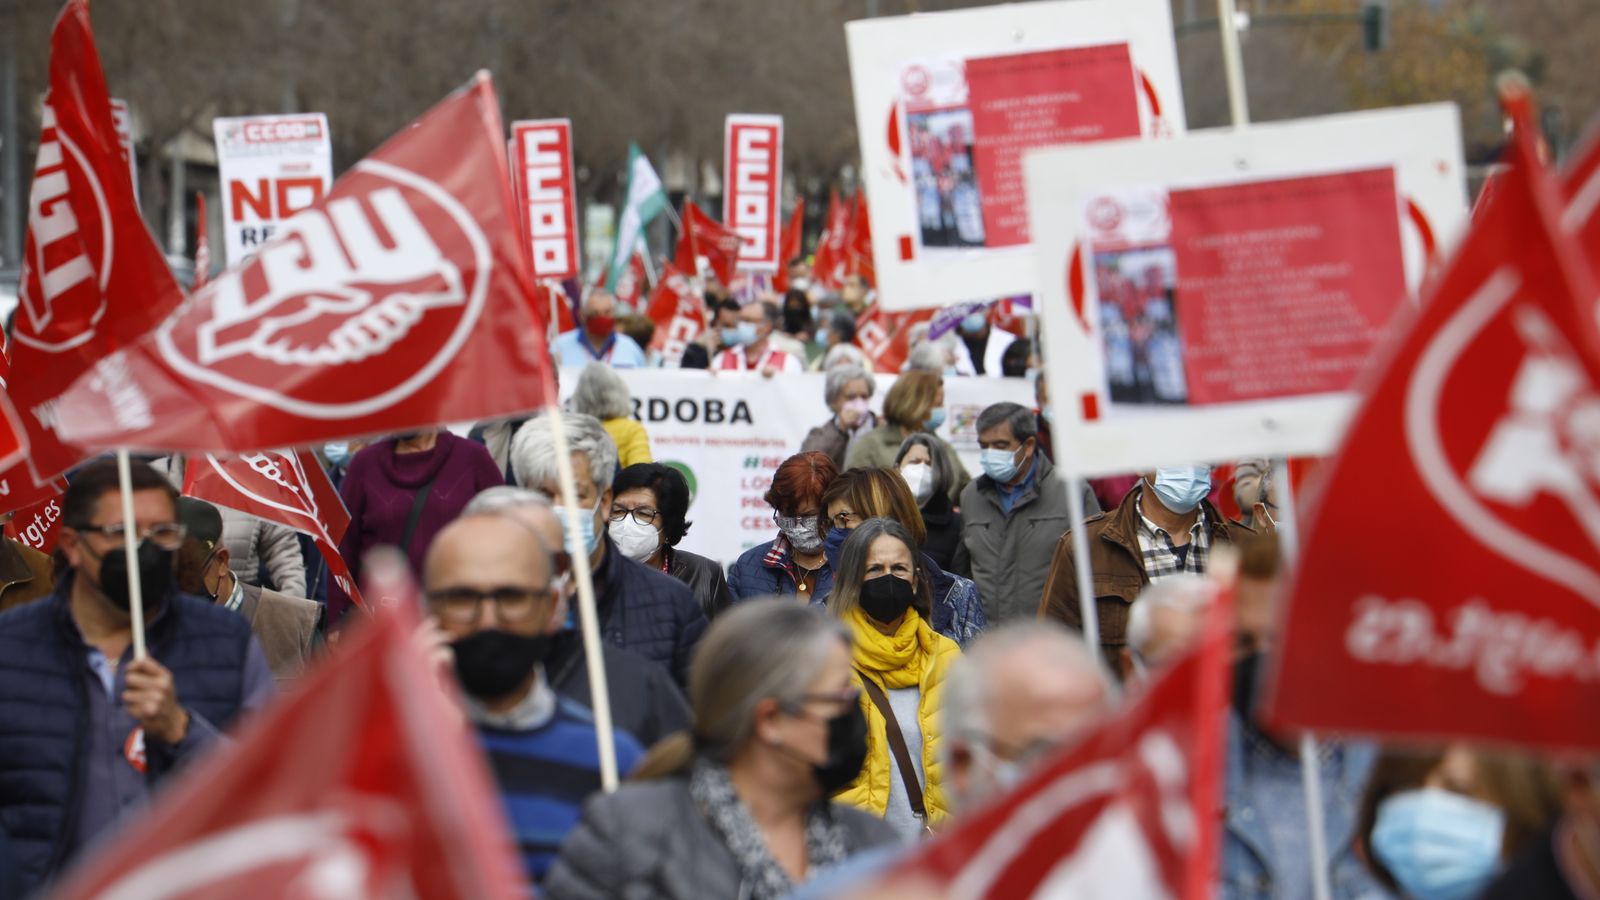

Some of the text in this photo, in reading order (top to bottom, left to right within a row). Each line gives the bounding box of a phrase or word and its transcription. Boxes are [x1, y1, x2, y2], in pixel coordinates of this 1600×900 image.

[230, 177, 324, 221] NO
[524, 129, 568, 274] CCOO
[736, 128, 771, 258] CCOO
